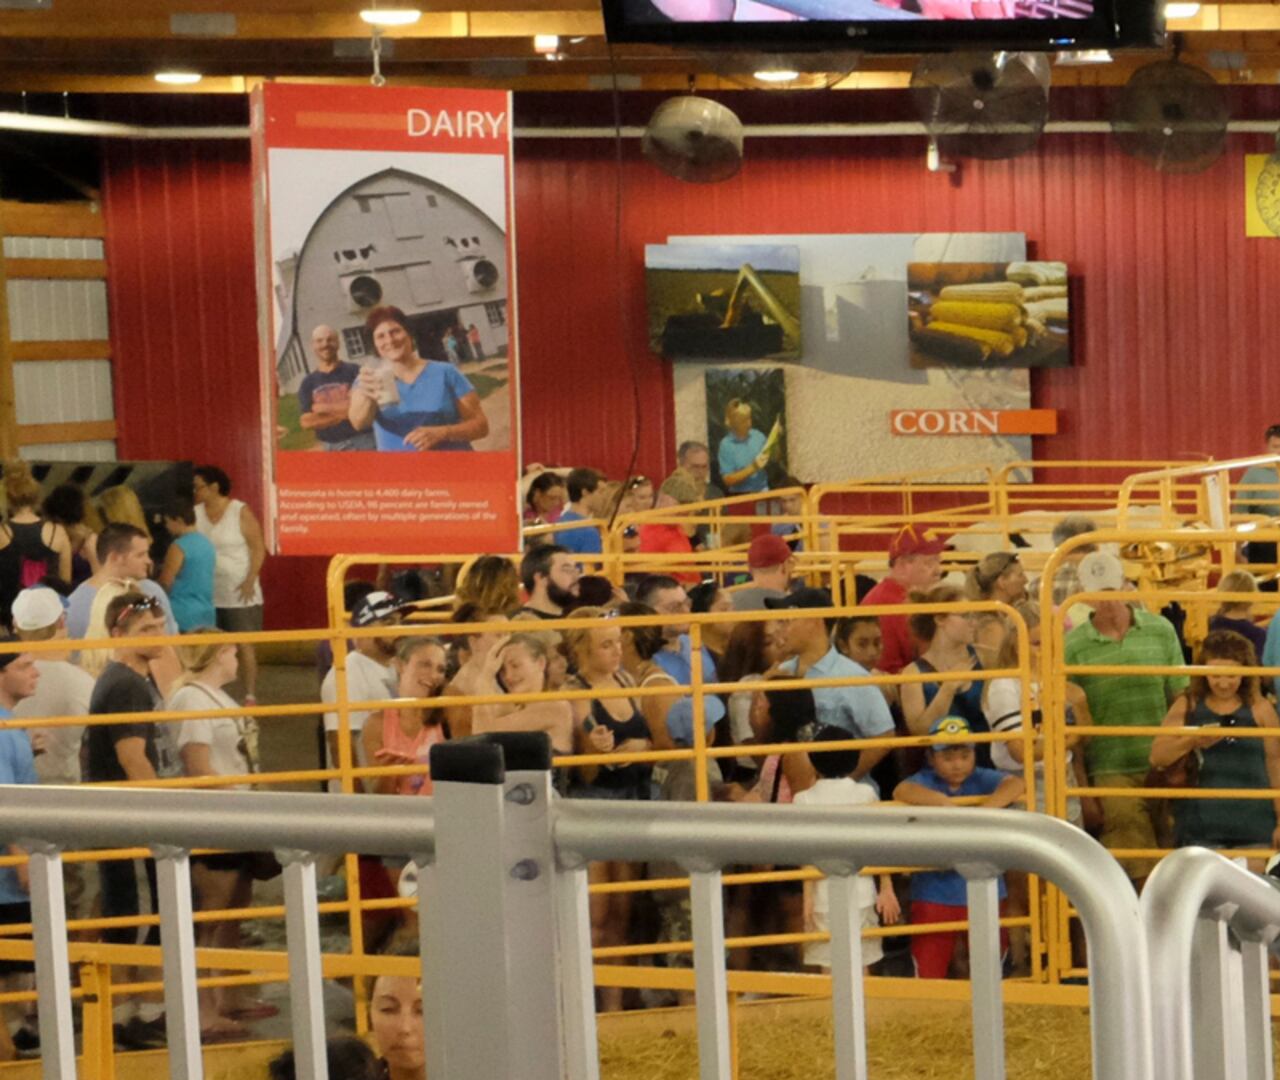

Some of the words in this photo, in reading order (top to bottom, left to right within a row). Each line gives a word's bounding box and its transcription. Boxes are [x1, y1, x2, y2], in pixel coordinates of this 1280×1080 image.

[407, 108, 505, 138] DAIRY
[894, 411, 1000, 433] CORN
[279, 489, 326, 498] Minnesota
[328, 489, 335, 498] is
[336, 489, 362, 498] home
[364, 489, 374, 498] to
[401, 489, 422, 499] dairy
[327, 500, 337, 509] to
[280, 513, 298, 521] and
[482, 513, 497, 521] the
